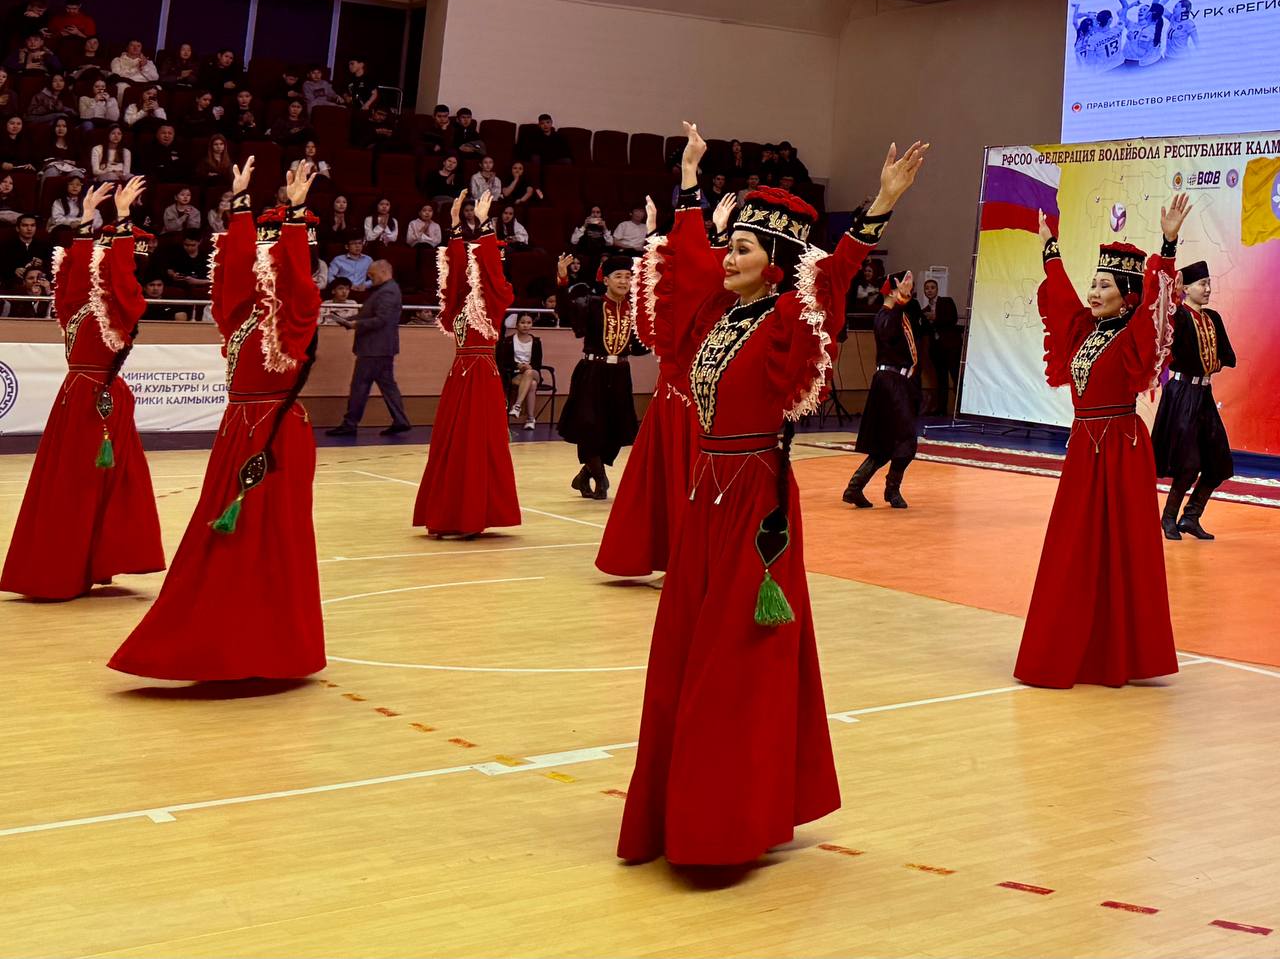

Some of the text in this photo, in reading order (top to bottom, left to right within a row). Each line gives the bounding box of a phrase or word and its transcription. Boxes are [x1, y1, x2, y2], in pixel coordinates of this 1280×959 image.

[1203, 5, 1224, 19] РК
[1086, 96, 1164, 110] ПРАВИТЕЛЬСТВО
[1165, 90, 1231, 104] РЕСПУБЛИКИ
[1001, 152, 1033, 166] РФСОО
[1034, 149, 1096, 166] «ФЕДЕРАЦИЯ
[1098, 143, 1160, 162] ВОЛЕЙБОЛА
[1163, 141, 1242, 159] РЕСПУБЛИКИ
[1196, 170, 1221, 185] ВФВ
[122, 372, 205, 381] МИНИСТЕРСТВО
[144, 384, 200, 393] КУЛЬТУРЫ
[166, 395, 225, 405] КАЛМЫКИЯ
